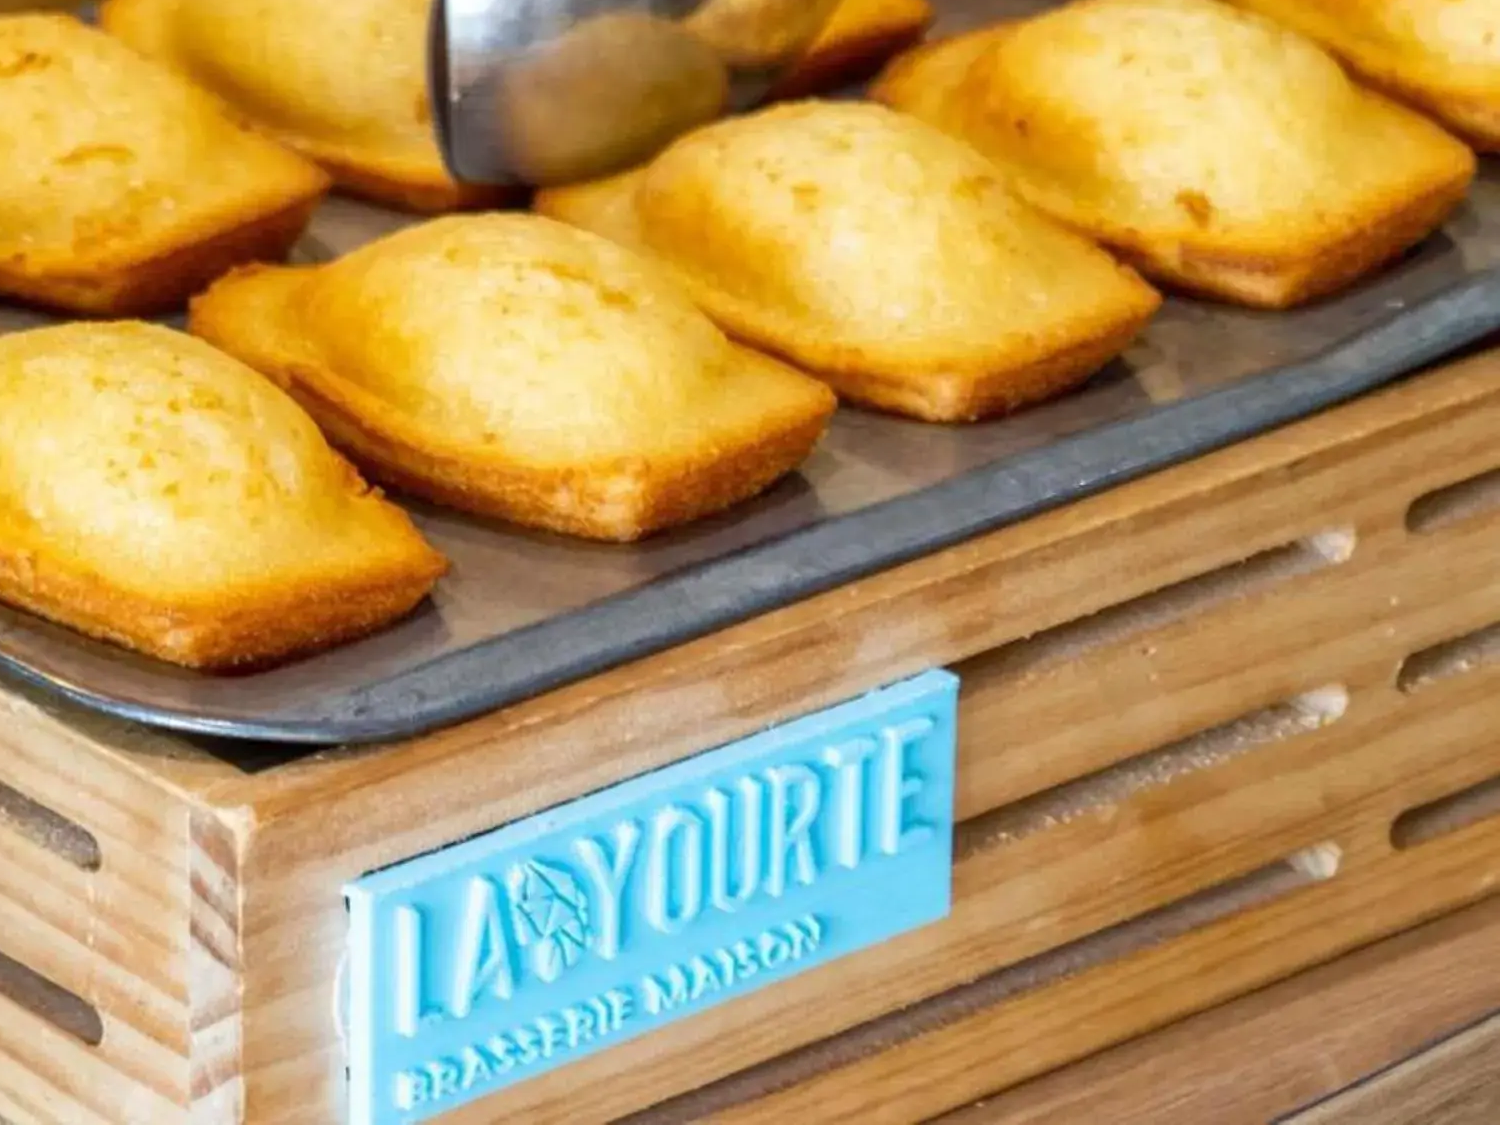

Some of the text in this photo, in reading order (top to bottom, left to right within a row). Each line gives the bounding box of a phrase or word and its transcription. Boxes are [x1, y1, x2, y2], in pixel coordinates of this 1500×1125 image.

[575, 717, 937, 960] YOURTE
[394, 914, 824, 1111] BRASSERIE MAISON
